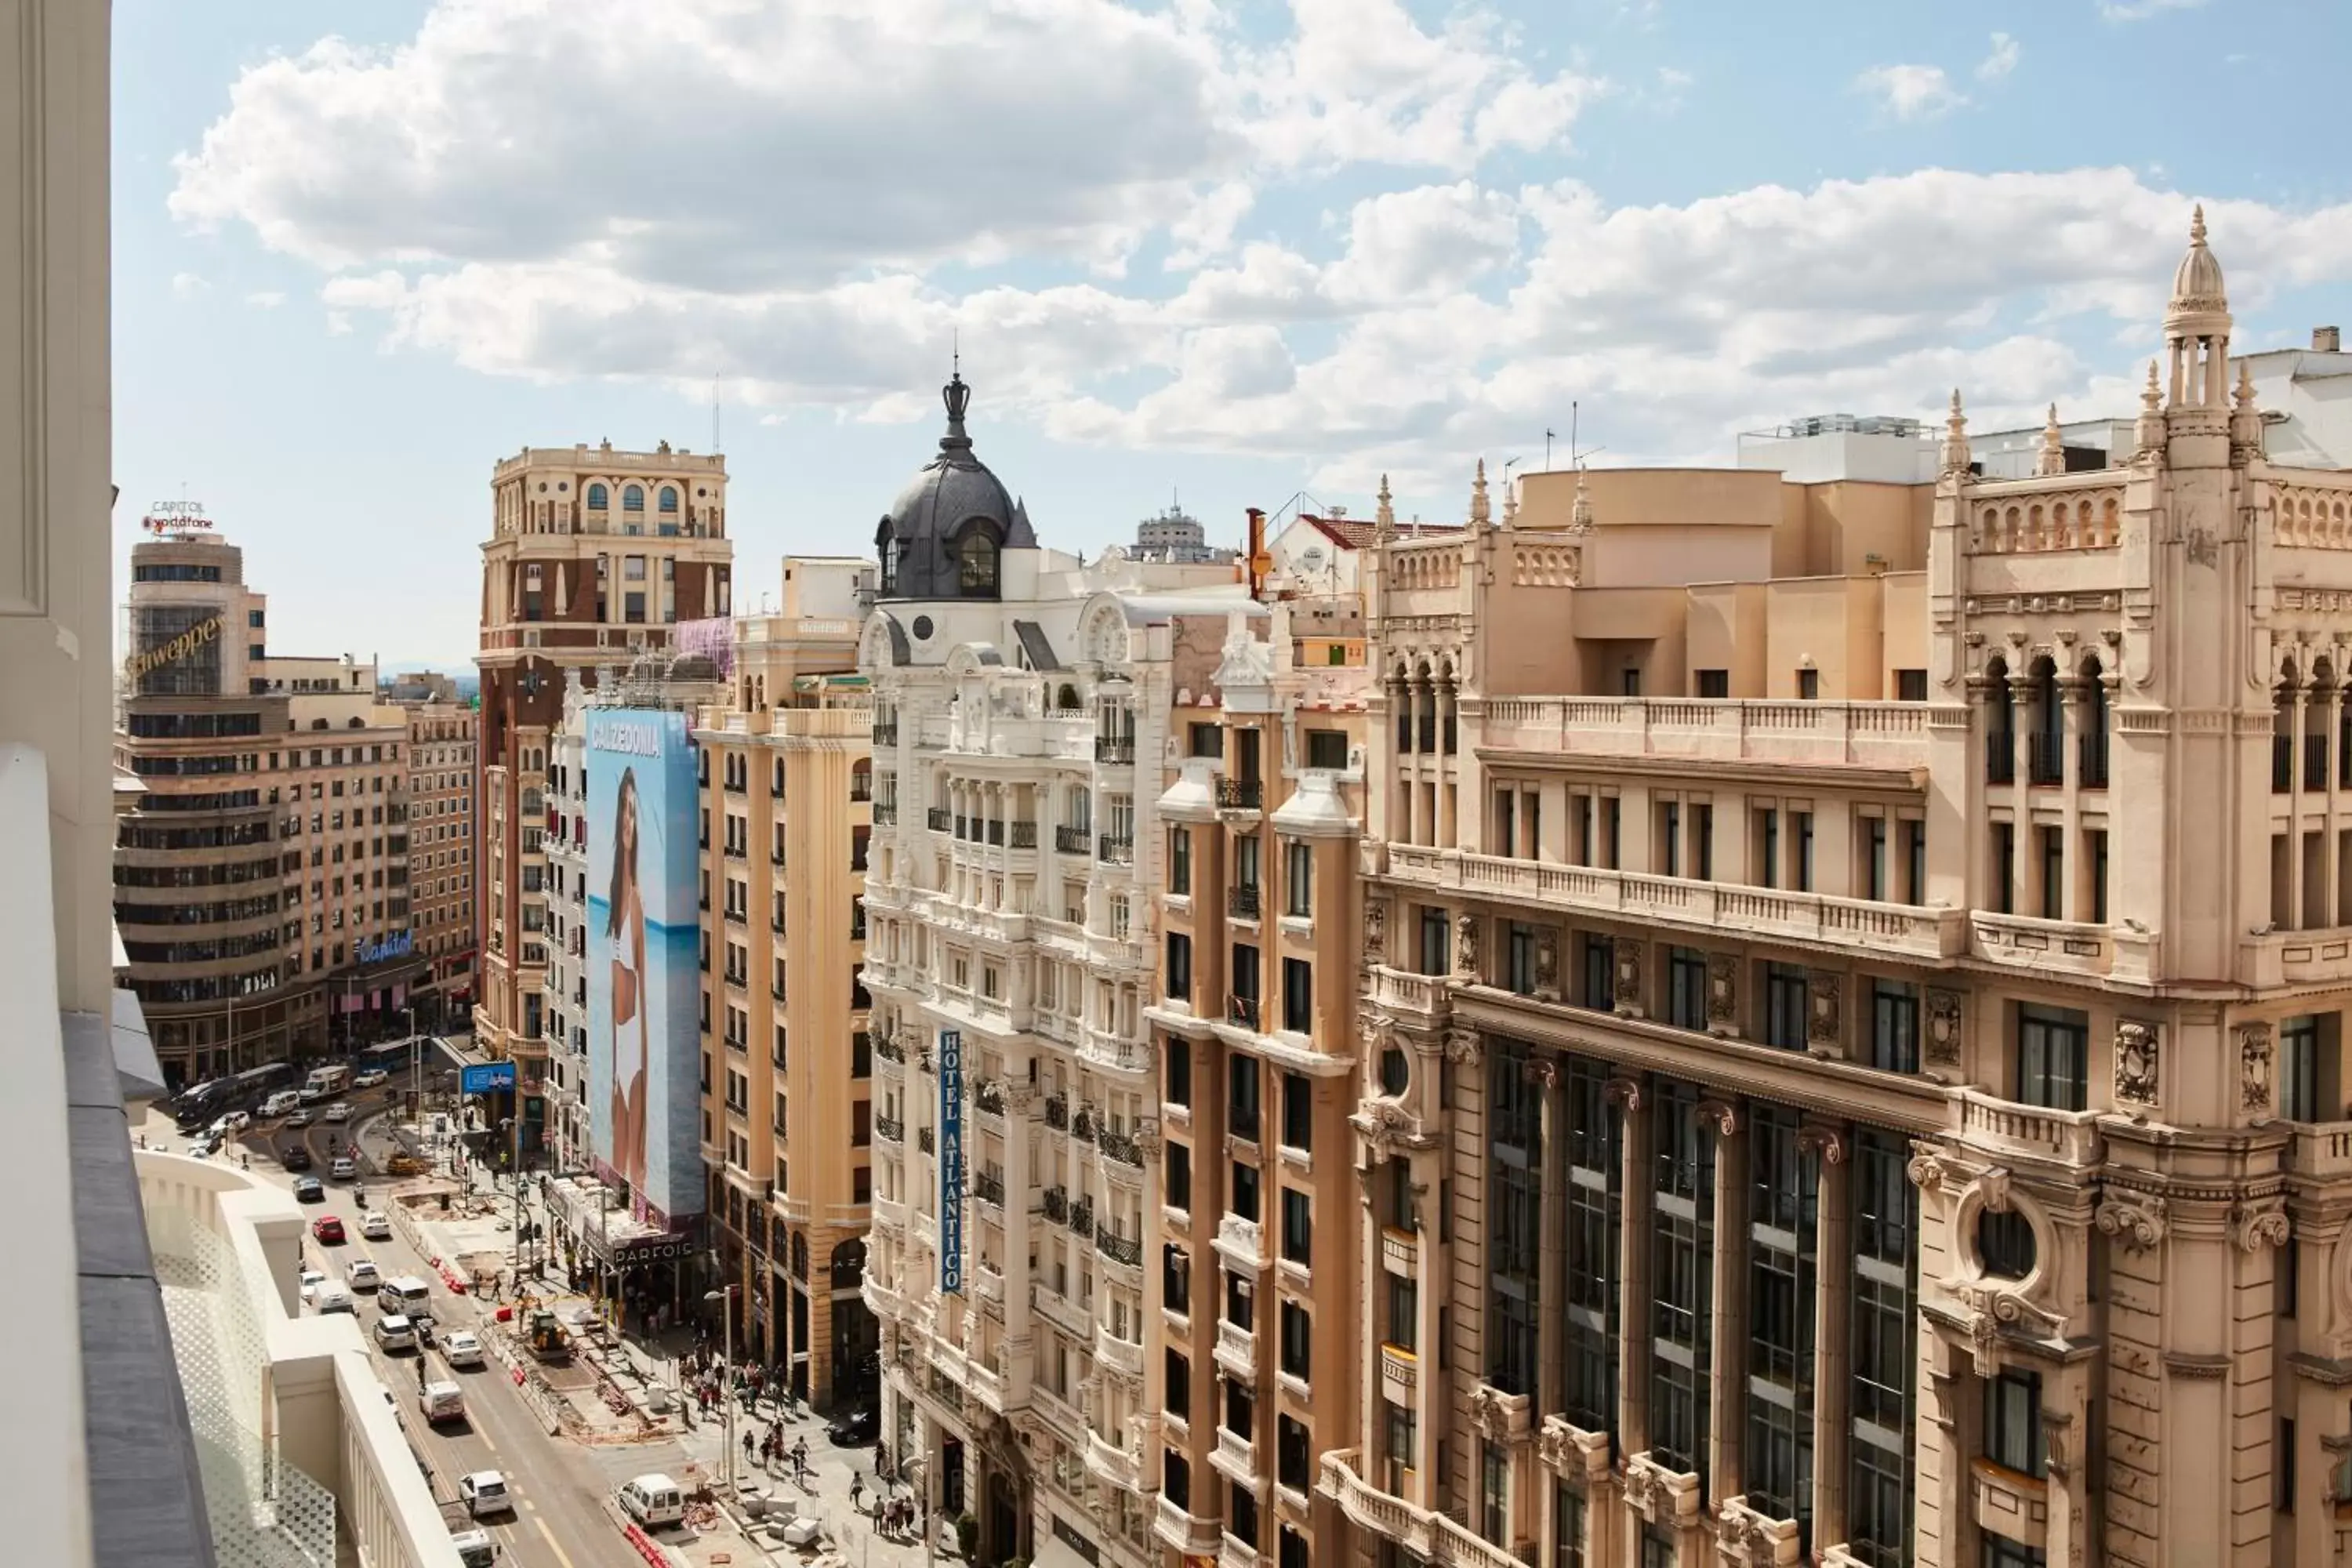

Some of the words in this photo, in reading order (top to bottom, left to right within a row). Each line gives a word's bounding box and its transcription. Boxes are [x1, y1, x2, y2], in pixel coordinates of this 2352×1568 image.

[154, 515, 212, 529] vodafone
[944, 1033, 958, 1120] HOTEL
[945, 1132, 959, 1287] ATLANTICO
